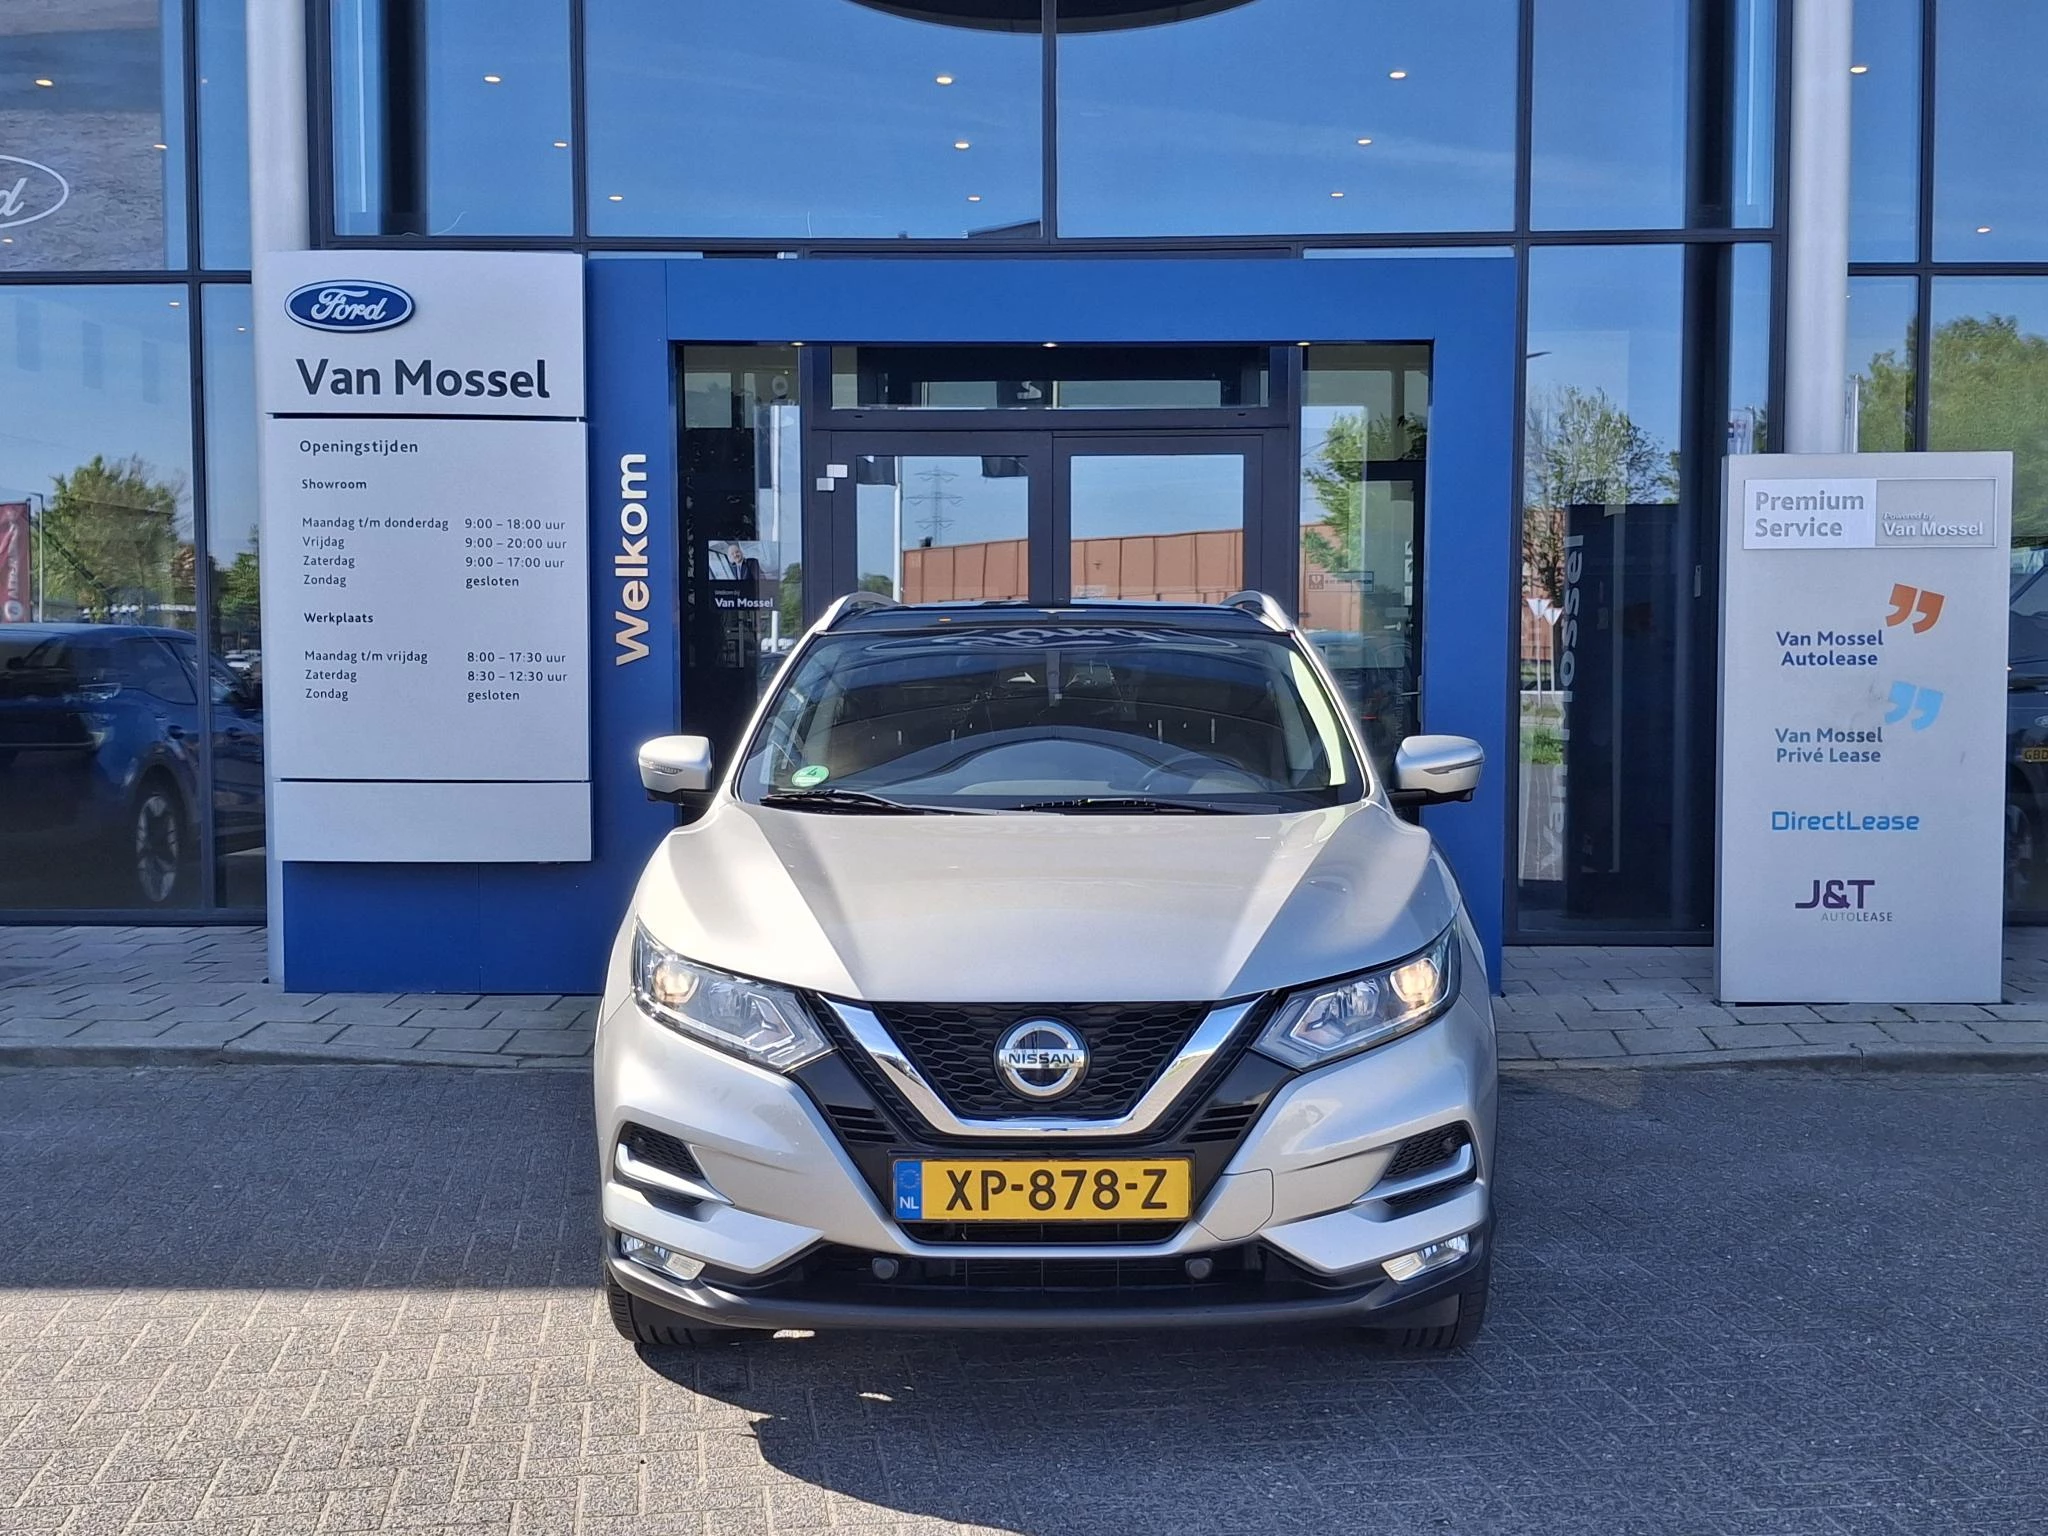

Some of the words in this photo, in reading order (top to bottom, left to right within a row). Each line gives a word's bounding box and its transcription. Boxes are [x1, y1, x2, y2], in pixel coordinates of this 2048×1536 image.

[310, 289, 388, 321] Ford
[296, 359, 380, 395] Van
[395, 359, 550, 398] Mossel
[300, 440, 418, 456] Openingstijden
[302, 479, 367, 489] Showroom
[1756, 490, 1864, 511] Premium
[303, 517, 355, 531] Maandag
[359, 517, 380, 528] t/m
[385, 517, 448, 531] donderdag
[465, 519, 492, 528] 9:00
[507, 519, 541, 529] 18:00
[1756, 517, 1842, 537] Service
[1882, 521, 1916, 536] Van
[1921, 521, 1983, 536] Mossel
[303, 536, 345, 549] Vrijdag
[465, 538, 492, 548] 9:00
[507, 538, 542, 548] 20:00
[304, 555, 355, 569] Zaterdag
[466, 557, 493, 567] 9:00
[508, 557, 540, 567] 17:00
[614, 452, 650, 666] Welkom
[304, 574, 346, 588] Zondag
[466, 576, 519, 589] gesloten
[714, 598, 734, 608] Van
[737, 598, 774, 608] Mossel
[304, 612, 373, 626] Werkplaats
[1550, 534, 1585, 742] Mossel
[1776, 631, 1811, 646] Van
[1818, 630, 1883, 646] Mossel
[305, 650, 358, 664] Maandag
[362, 651, 382, 661] t/m
[387, 651, 427, 664] vrijdag
[468, 652, 494, 662] 8:00
[510, 652, 543, 662] 17:30
[1781, 650, 1878, 665] Autolease
[306, 669, 357, 683] Zaterdag
[468, 671, 494, 681] 8:30
[510, 671, 543, 681] 12:30
[306, 688, 348, 701] Zondag
[468, 690, 520, 703] gesloten
[1775, 728, 1810, 743] Van
[1817, 727, 1883, 743] Mossel
[1777, 747, 1823, 762] Privé
[1830, 748, 1881, 762] Lease
[1539, 764, 1569, 873] Van
[1772, 811, 1919, 830] DirectLease
[1795, 880, 1875, 909] J&T
[1823, 912, 1892, 922] AUTOLEASE
[1008, 1053, 1075, 1064] NISSAN
[945, 1168, 1168, 1211] XP-878-Z
[900, 1197, 919, 1209] NL
